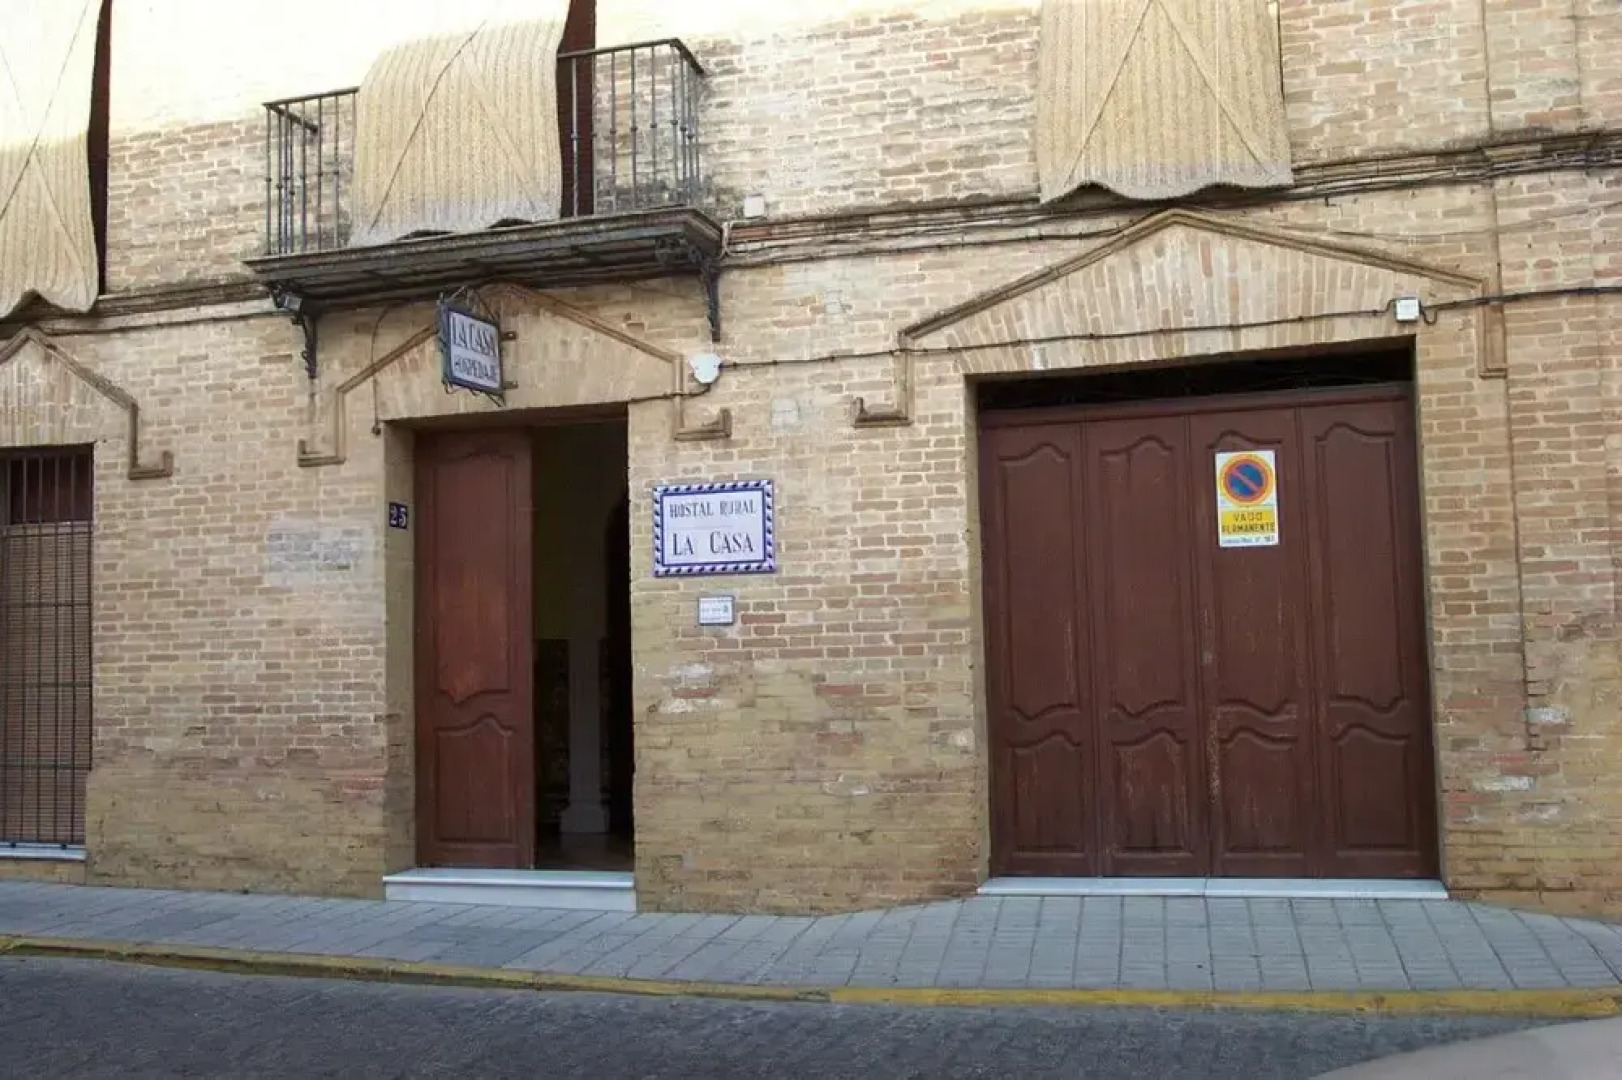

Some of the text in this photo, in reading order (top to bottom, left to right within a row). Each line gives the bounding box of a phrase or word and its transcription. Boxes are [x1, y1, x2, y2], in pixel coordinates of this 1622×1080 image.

[451, 315, 498, 358] LA CASA
[391, 505, 406, 527] 25
[669, 499, 757, 518] HOSTAL RURAL
[1233, 512, 1263, 522] VADO
